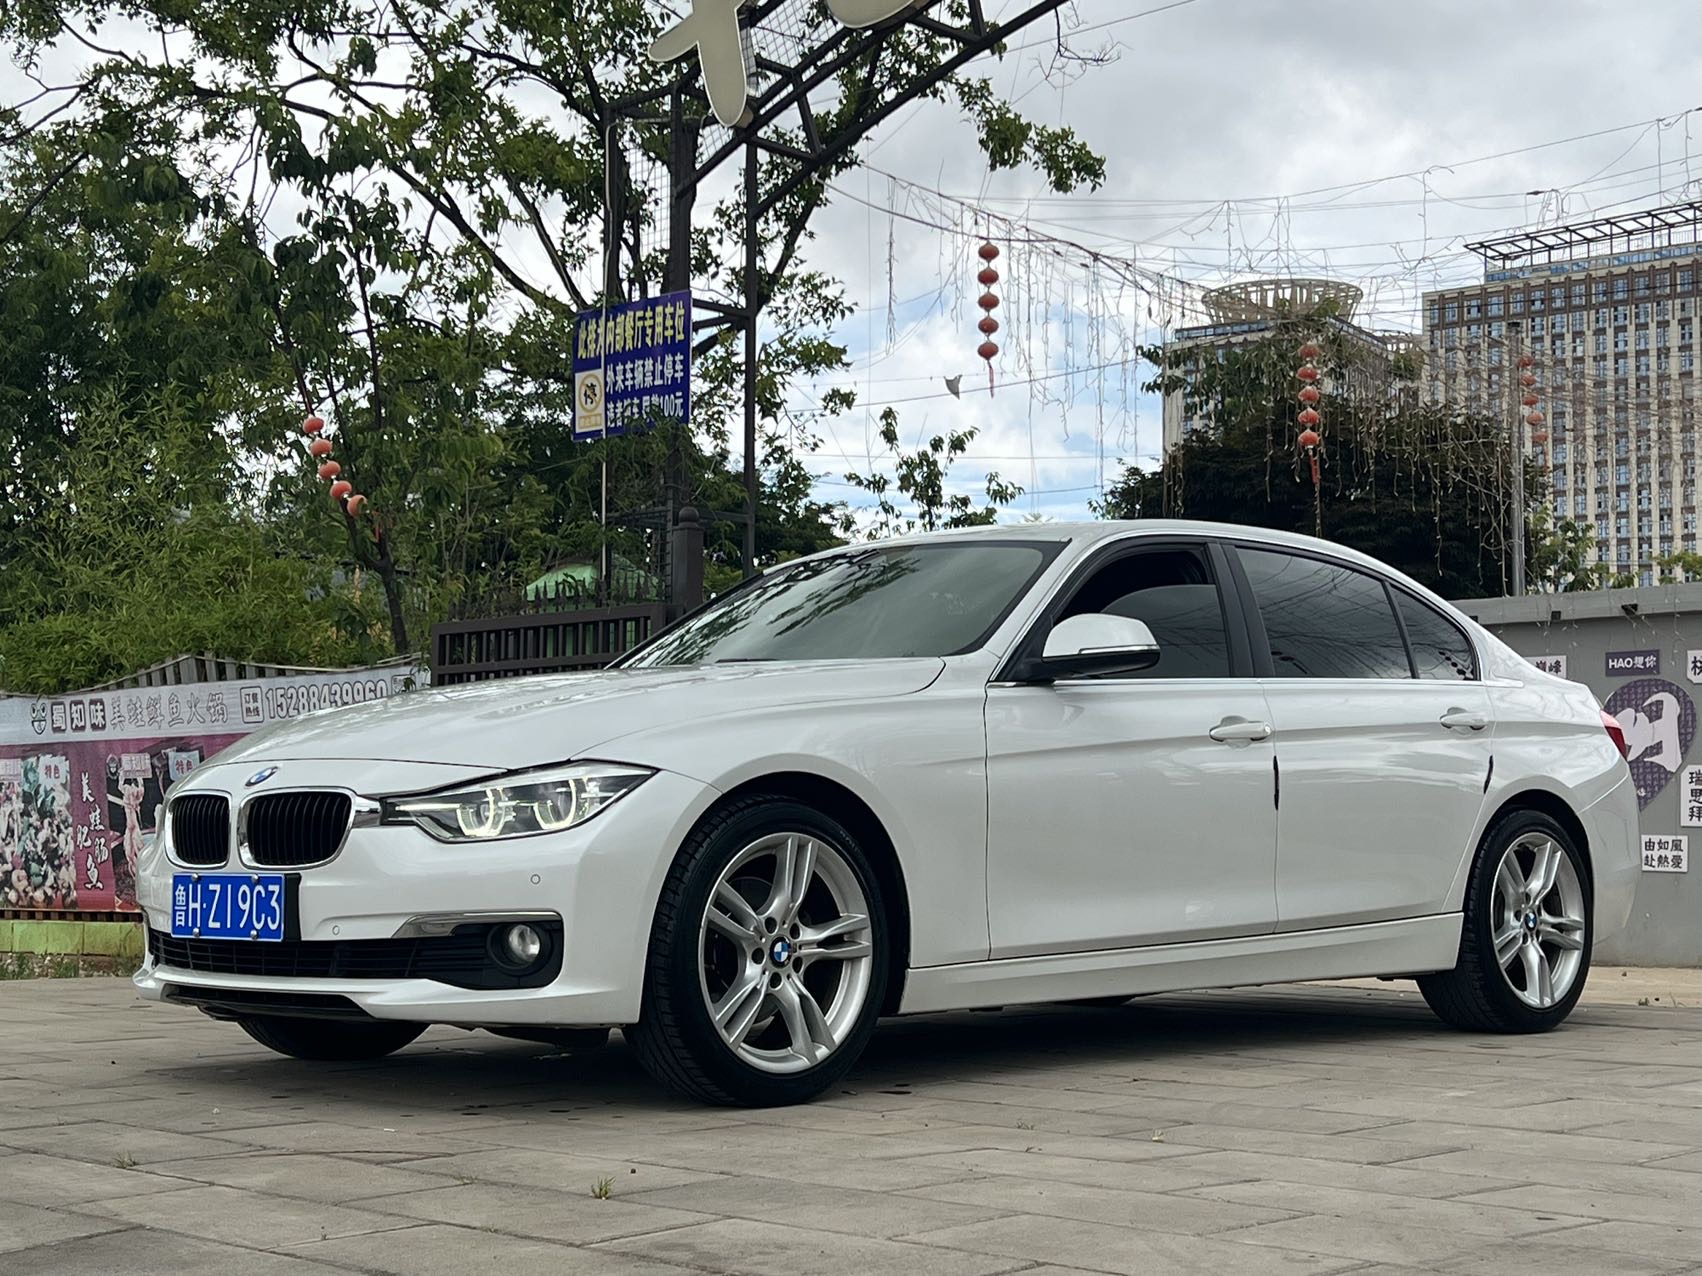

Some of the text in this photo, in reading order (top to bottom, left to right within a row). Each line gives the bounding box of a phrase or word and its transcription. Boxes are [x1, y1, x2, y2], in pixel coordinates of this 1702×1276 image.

[606, 352, 684, 394] 外来车辆禁止停车
[51, 698, 106, 732] 蜀知味
